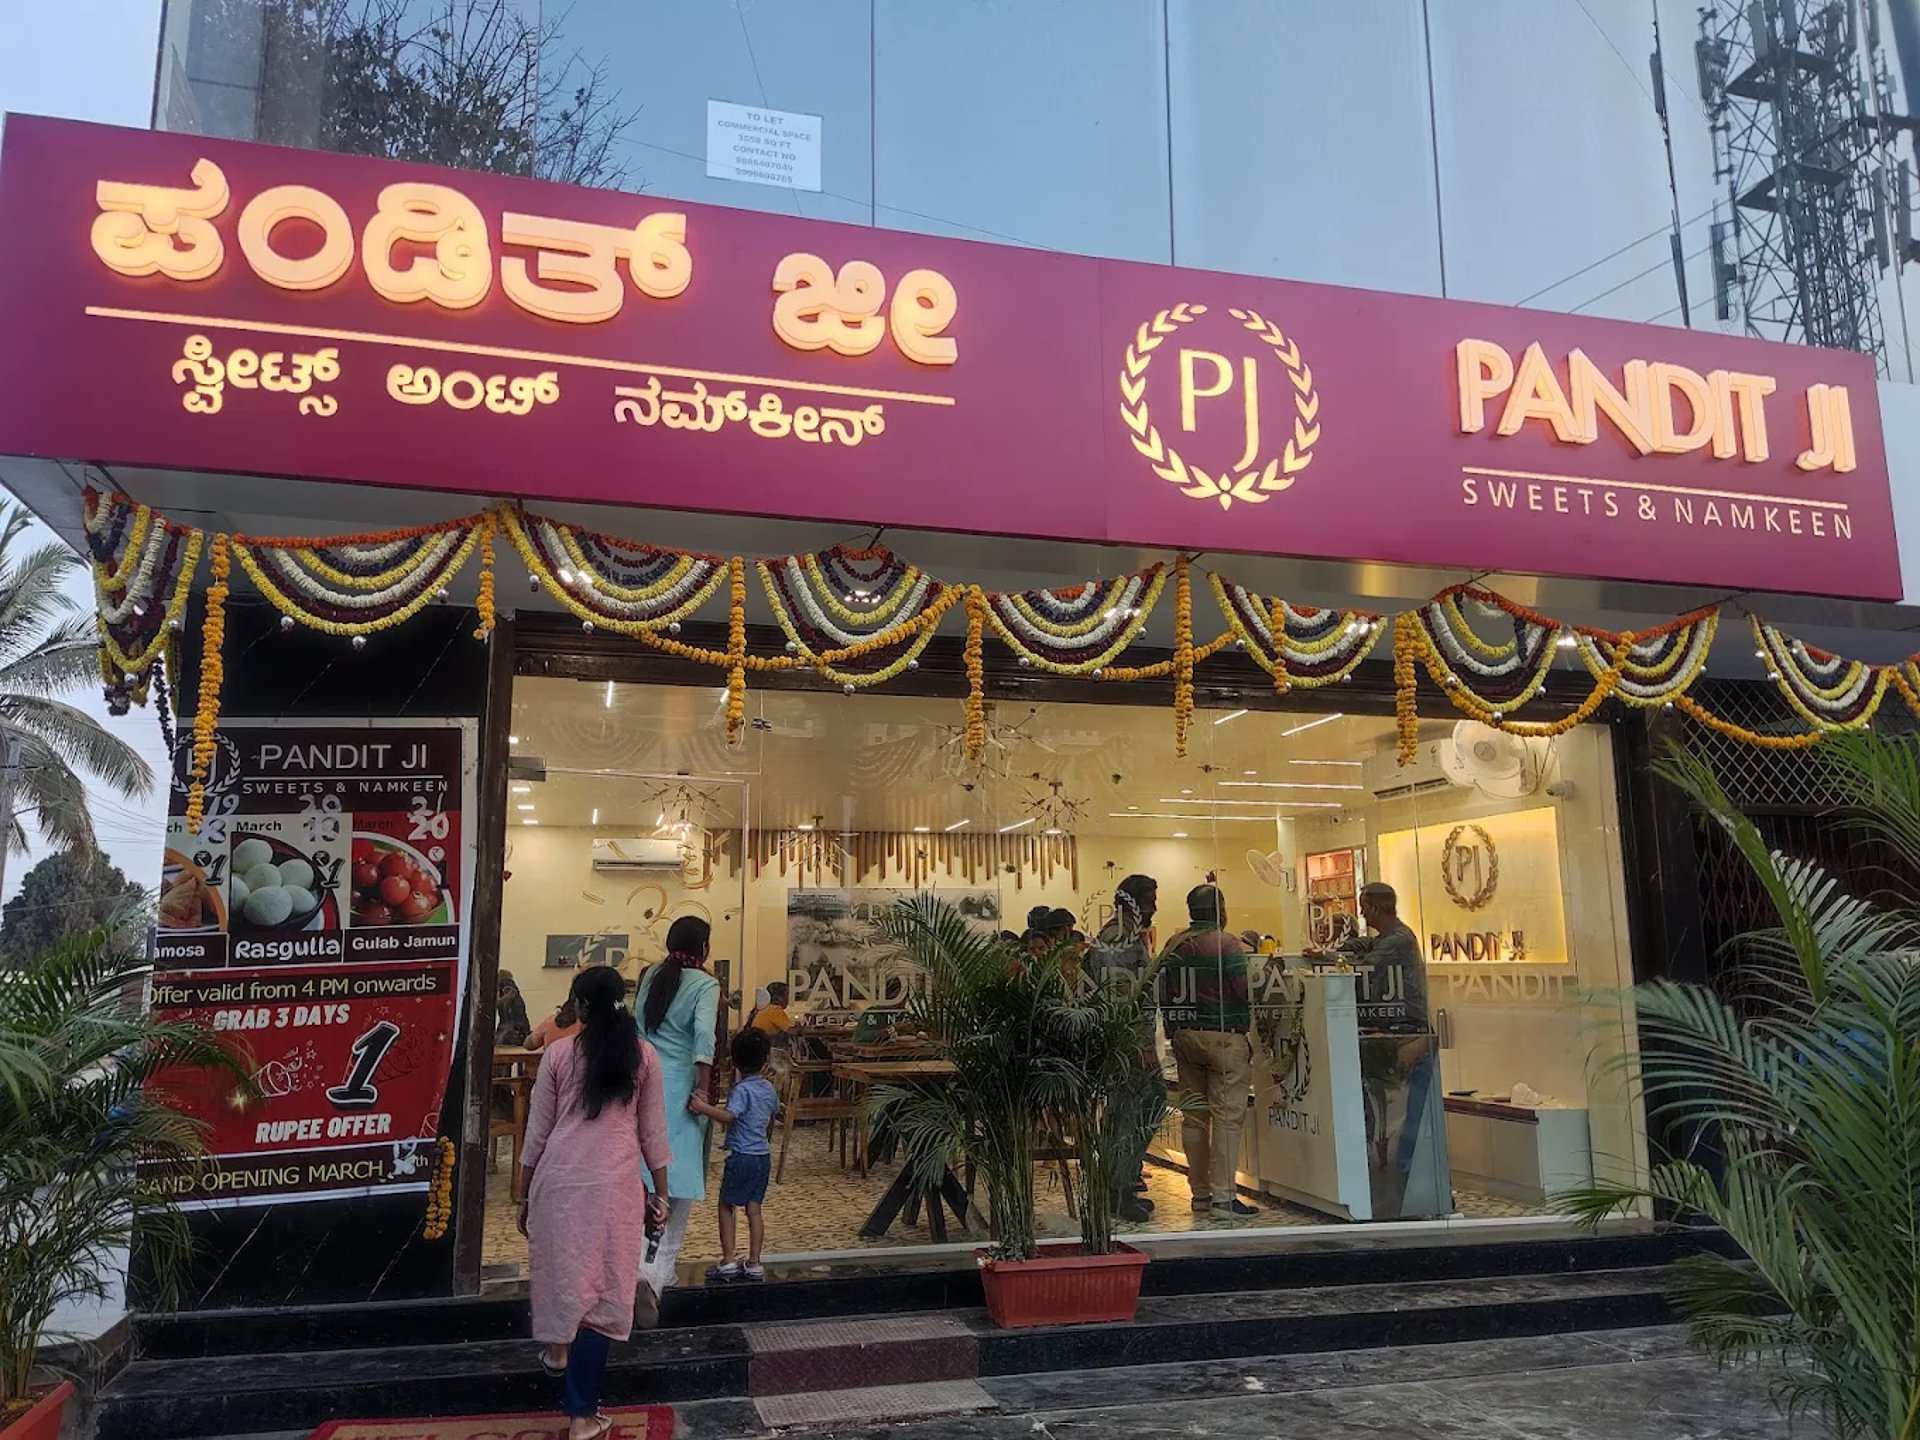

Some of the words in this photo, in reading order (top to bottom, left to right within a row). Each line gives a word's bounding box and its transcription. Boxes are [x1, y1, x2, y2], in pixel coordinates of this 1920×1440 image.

[717, 119, 781, 136] COMMERCIAL
[782, 129, 812, 142] SPACE
[746, 112, 761, 121] TO
[764, 116, 785, 125] LET
[732, 144, 779, 158] CONTACT
[781, 152, 797, 161] NO
[763, 137, 777, 147] SQ
[779, 141, 792, 149] FT
[90, 157, 693, 323] ಪಂಡಿತ್
[1179, 348, 1260, 473] PJ
[1456, 338, 1776, 463] PANDIT
[1796, 383, 1857, 473] JI
[1462, 479, 1620, 517] SWEETS
[1637, 493, 1657, 521] &
[1674, 495, 1853, 540] NAMKEEN
[258, 744, 392, 770] PANDIT
[401, 745, 428, 769] JI
[241, 782, 324, 795] SWEETS
[335, 782, 347, 793] &
[358, 780, 448, 793] NAMKEEN
[236, 821, 282, 832] March
[1455, 845, 1483, 898] PJ
[154, 945, 206, 959] amosa
[234, 936, 341, 962] Rasgulla
[351, 935, 400, 951] Gulab
[403, 933, 456, 949] Jamun
[1430, 931, 1502, 961] PANDIT
[197, 982, 244, 1002] valid
[249, 981, 296, 1000] from
[300, 980, 315, 996] 4
[319, 978, 349, 996] PM
[353, 973, 437, 994] onwards
[1173, 966, 1198, 1004] JI
[1381, 964, 1405, 1002] JI
[1447, 969, 1565, 1001] PANDIT
[213, 1007, 271, 1031] GRAB
[275, 1006, 291, 1027] 3
[293, 1003, 351, 1026] DAYS
[326, 1020, 400, 1104] 1
[254, 1118, 323, 1144] RUPEE
[327, 1113, 392, 1138] OFFER
[1268, 1105, 1309, 1134] PANDIT
[134, 1175, 196, 1195] RAND
[202, 1167, 300, 1191] OPENING
[308, 1160, 383, 1182] MARCH
